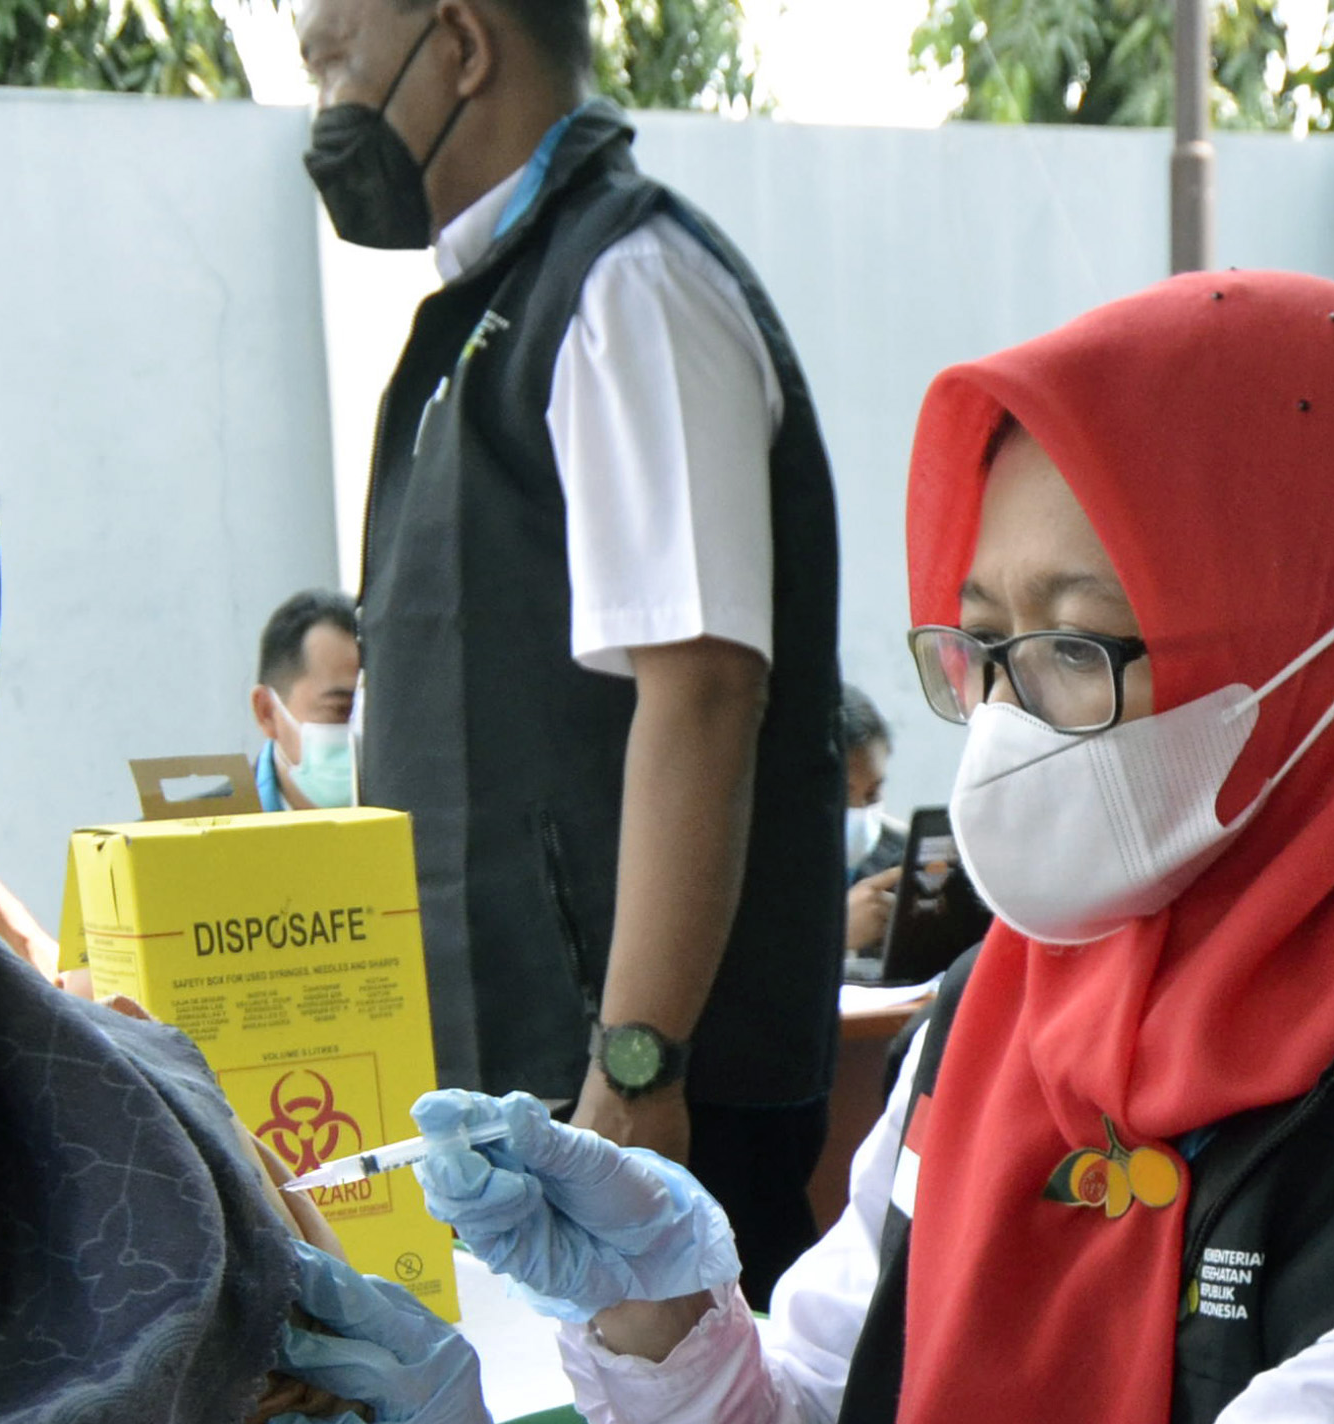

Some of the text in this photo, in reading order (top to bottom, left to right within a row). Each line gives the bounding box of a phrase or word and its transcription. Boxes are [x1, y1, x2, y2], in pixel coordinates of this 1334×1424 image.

[194, 907, 367, 957] DISPOSAFE
[172, 976, 205, 990] SAFETY
[206, 974, 225, 987] BOX
[226, 972, 244, 985] FOR
